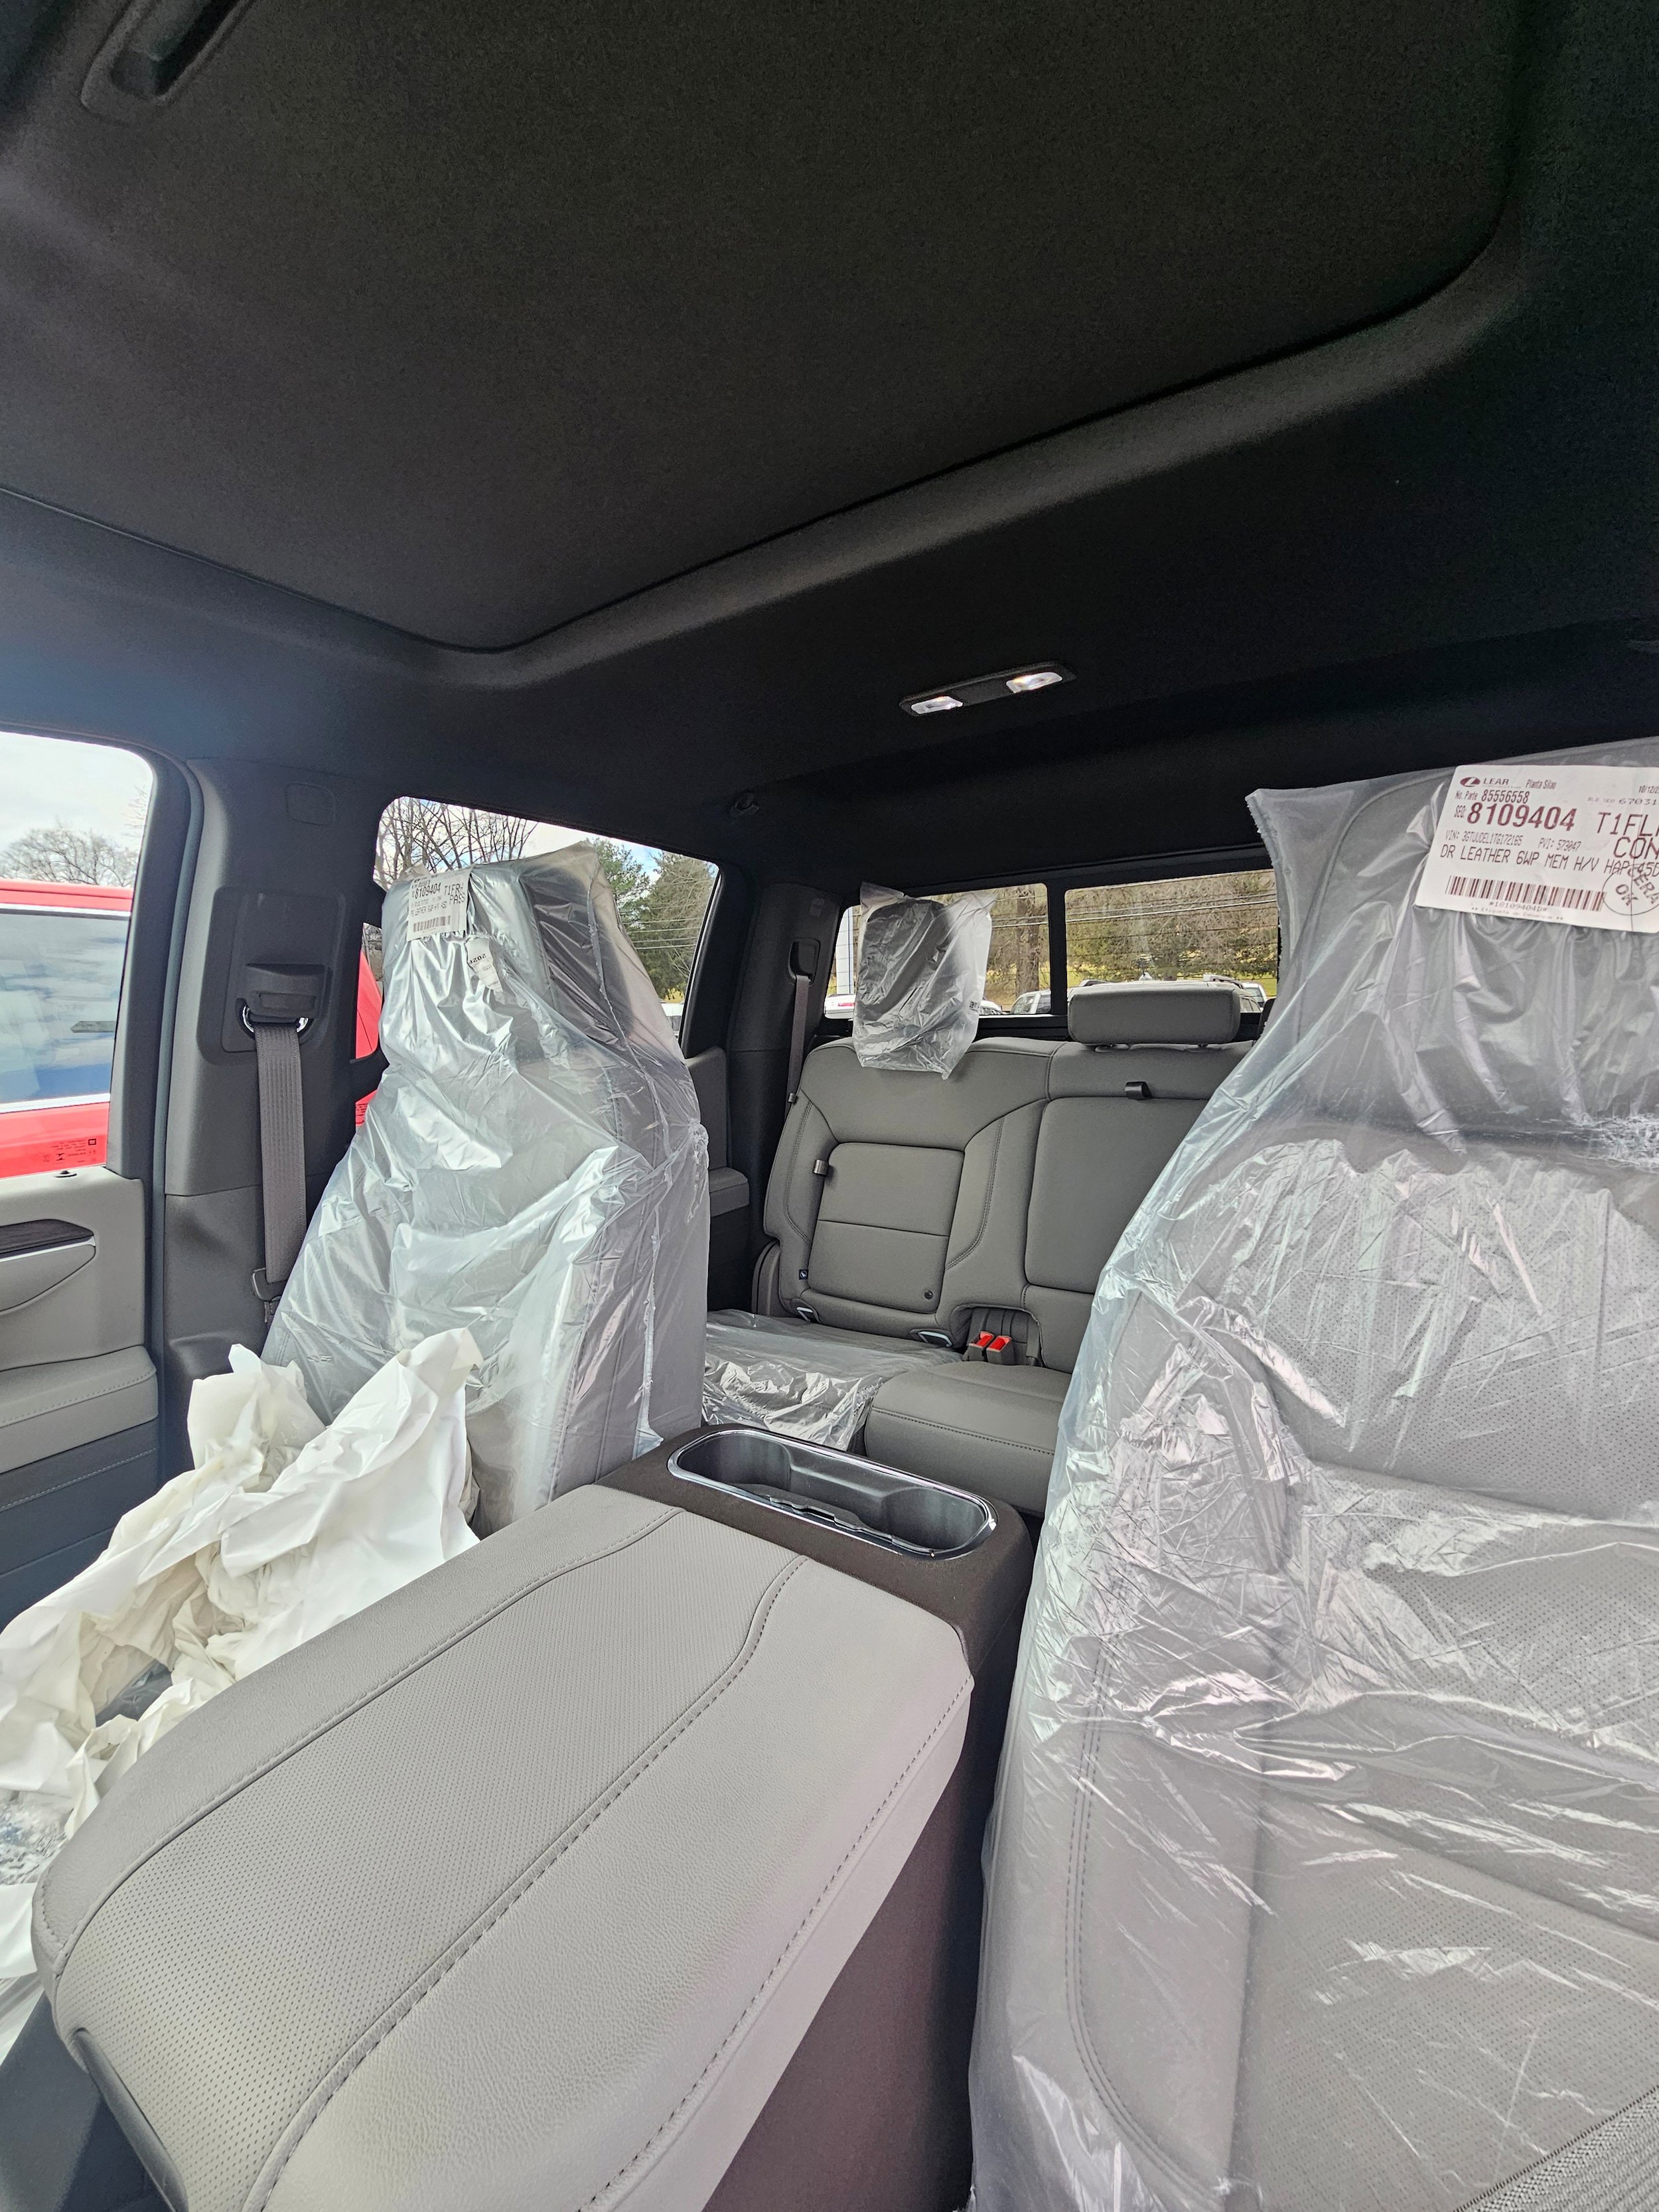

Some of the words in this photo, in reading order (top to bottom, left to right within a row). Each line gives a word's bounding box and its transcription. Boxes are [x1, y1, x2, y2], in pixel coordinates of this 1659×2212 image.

[1481, 789, 1530, 804] 85556558
[1467, 802, 1577, 831] 8109404
[1445, 830, 1459, 840] VIN:
[1538, 838, 1554, 849] PVI:
[1440, 844, 1456, 858] DR
[1460, 846, 1511, 863] LEATHER
[1516, 851, 1540, 865] 6WP
[1544, 853, 1571, 869] MEM
[1573, 856, 1600, 873] H/V
[1604, 859, 1630, 875] HAP
[415, 883, 441, 899] 8109404
[449, 892, 466, 905] PASS
[1615, 884, 1638, 906] OK
